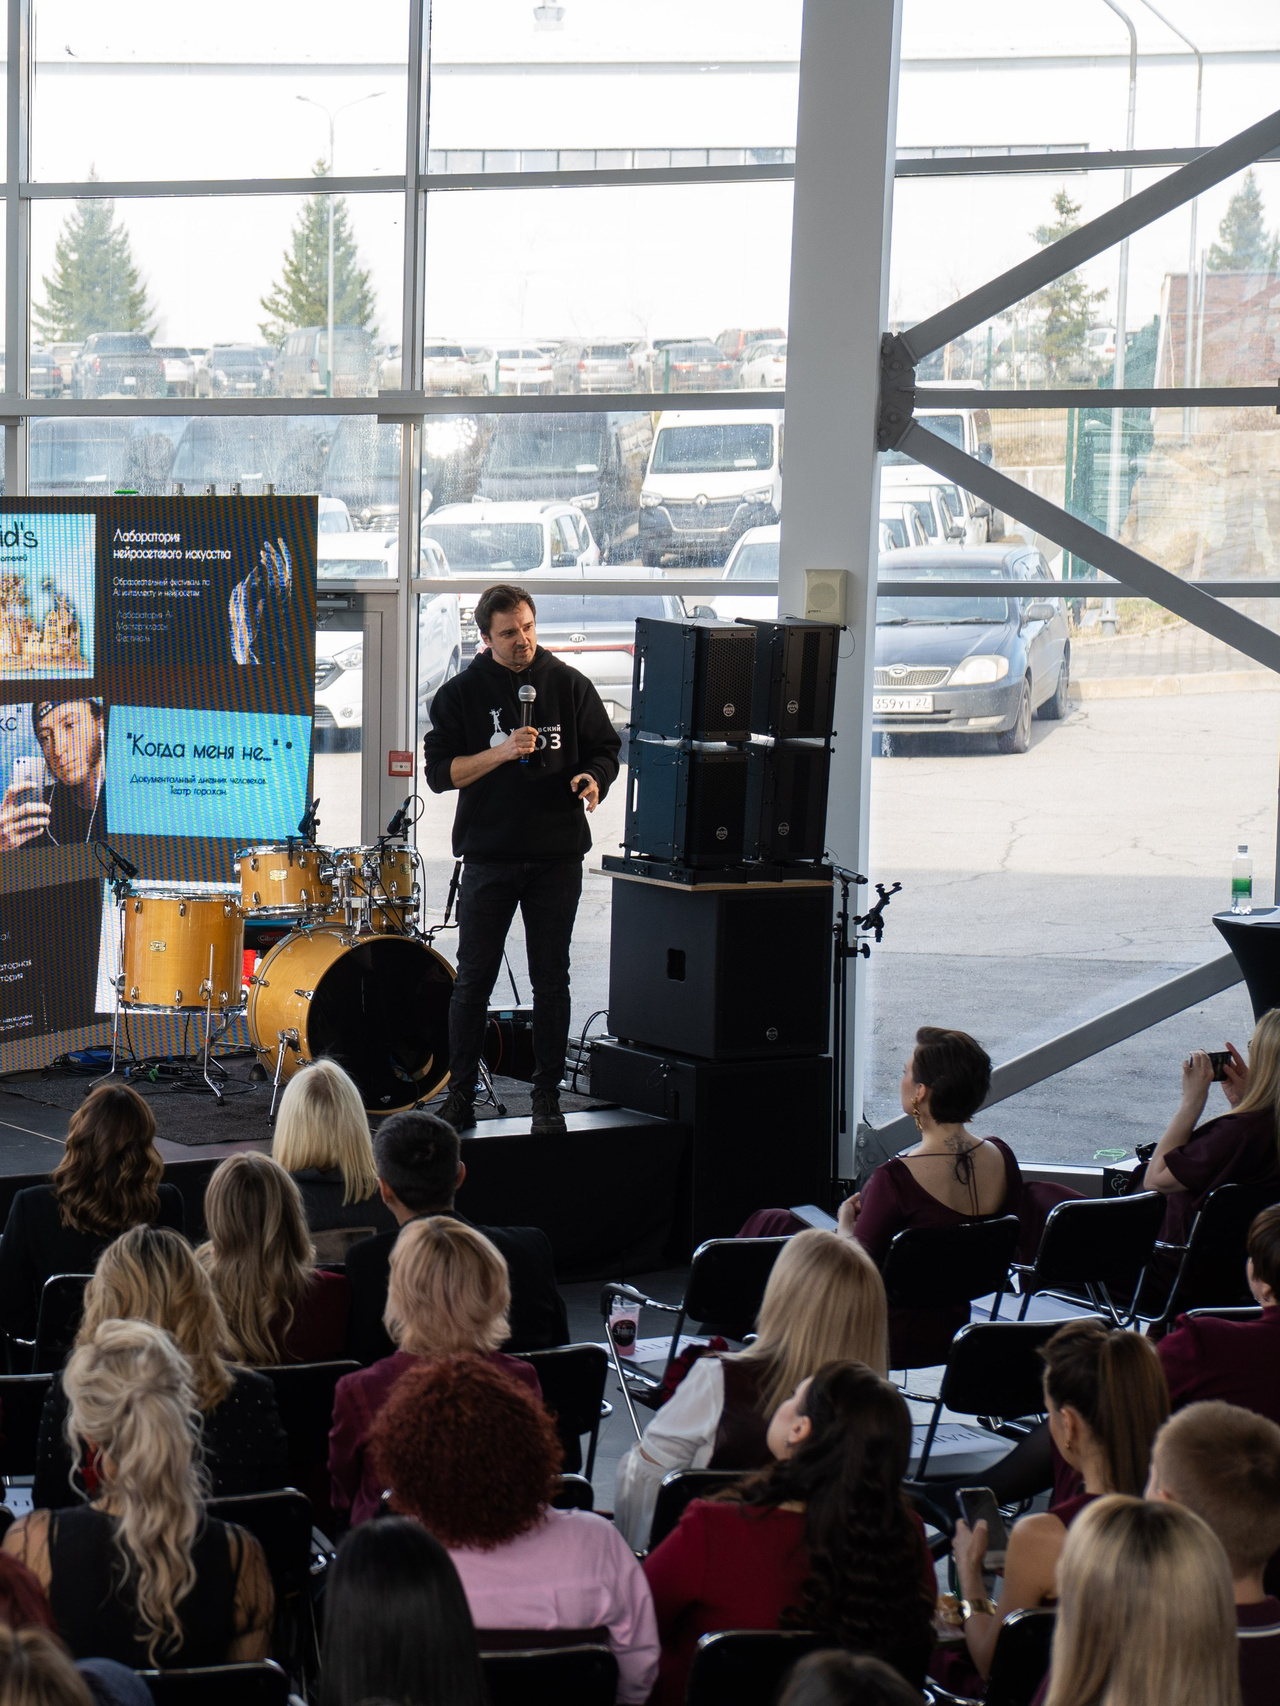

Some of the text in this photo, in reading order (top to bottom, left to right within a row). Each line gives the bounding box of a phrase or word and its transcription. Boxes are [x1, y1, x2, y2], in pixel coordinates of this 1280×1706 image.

[113, 528, 180, 545] Лаборатория
[113, 546, 231, 562] нейросетевого искусства
[193, 743, 235, 759] меня
[130, 773, 196, 785] Документальный
